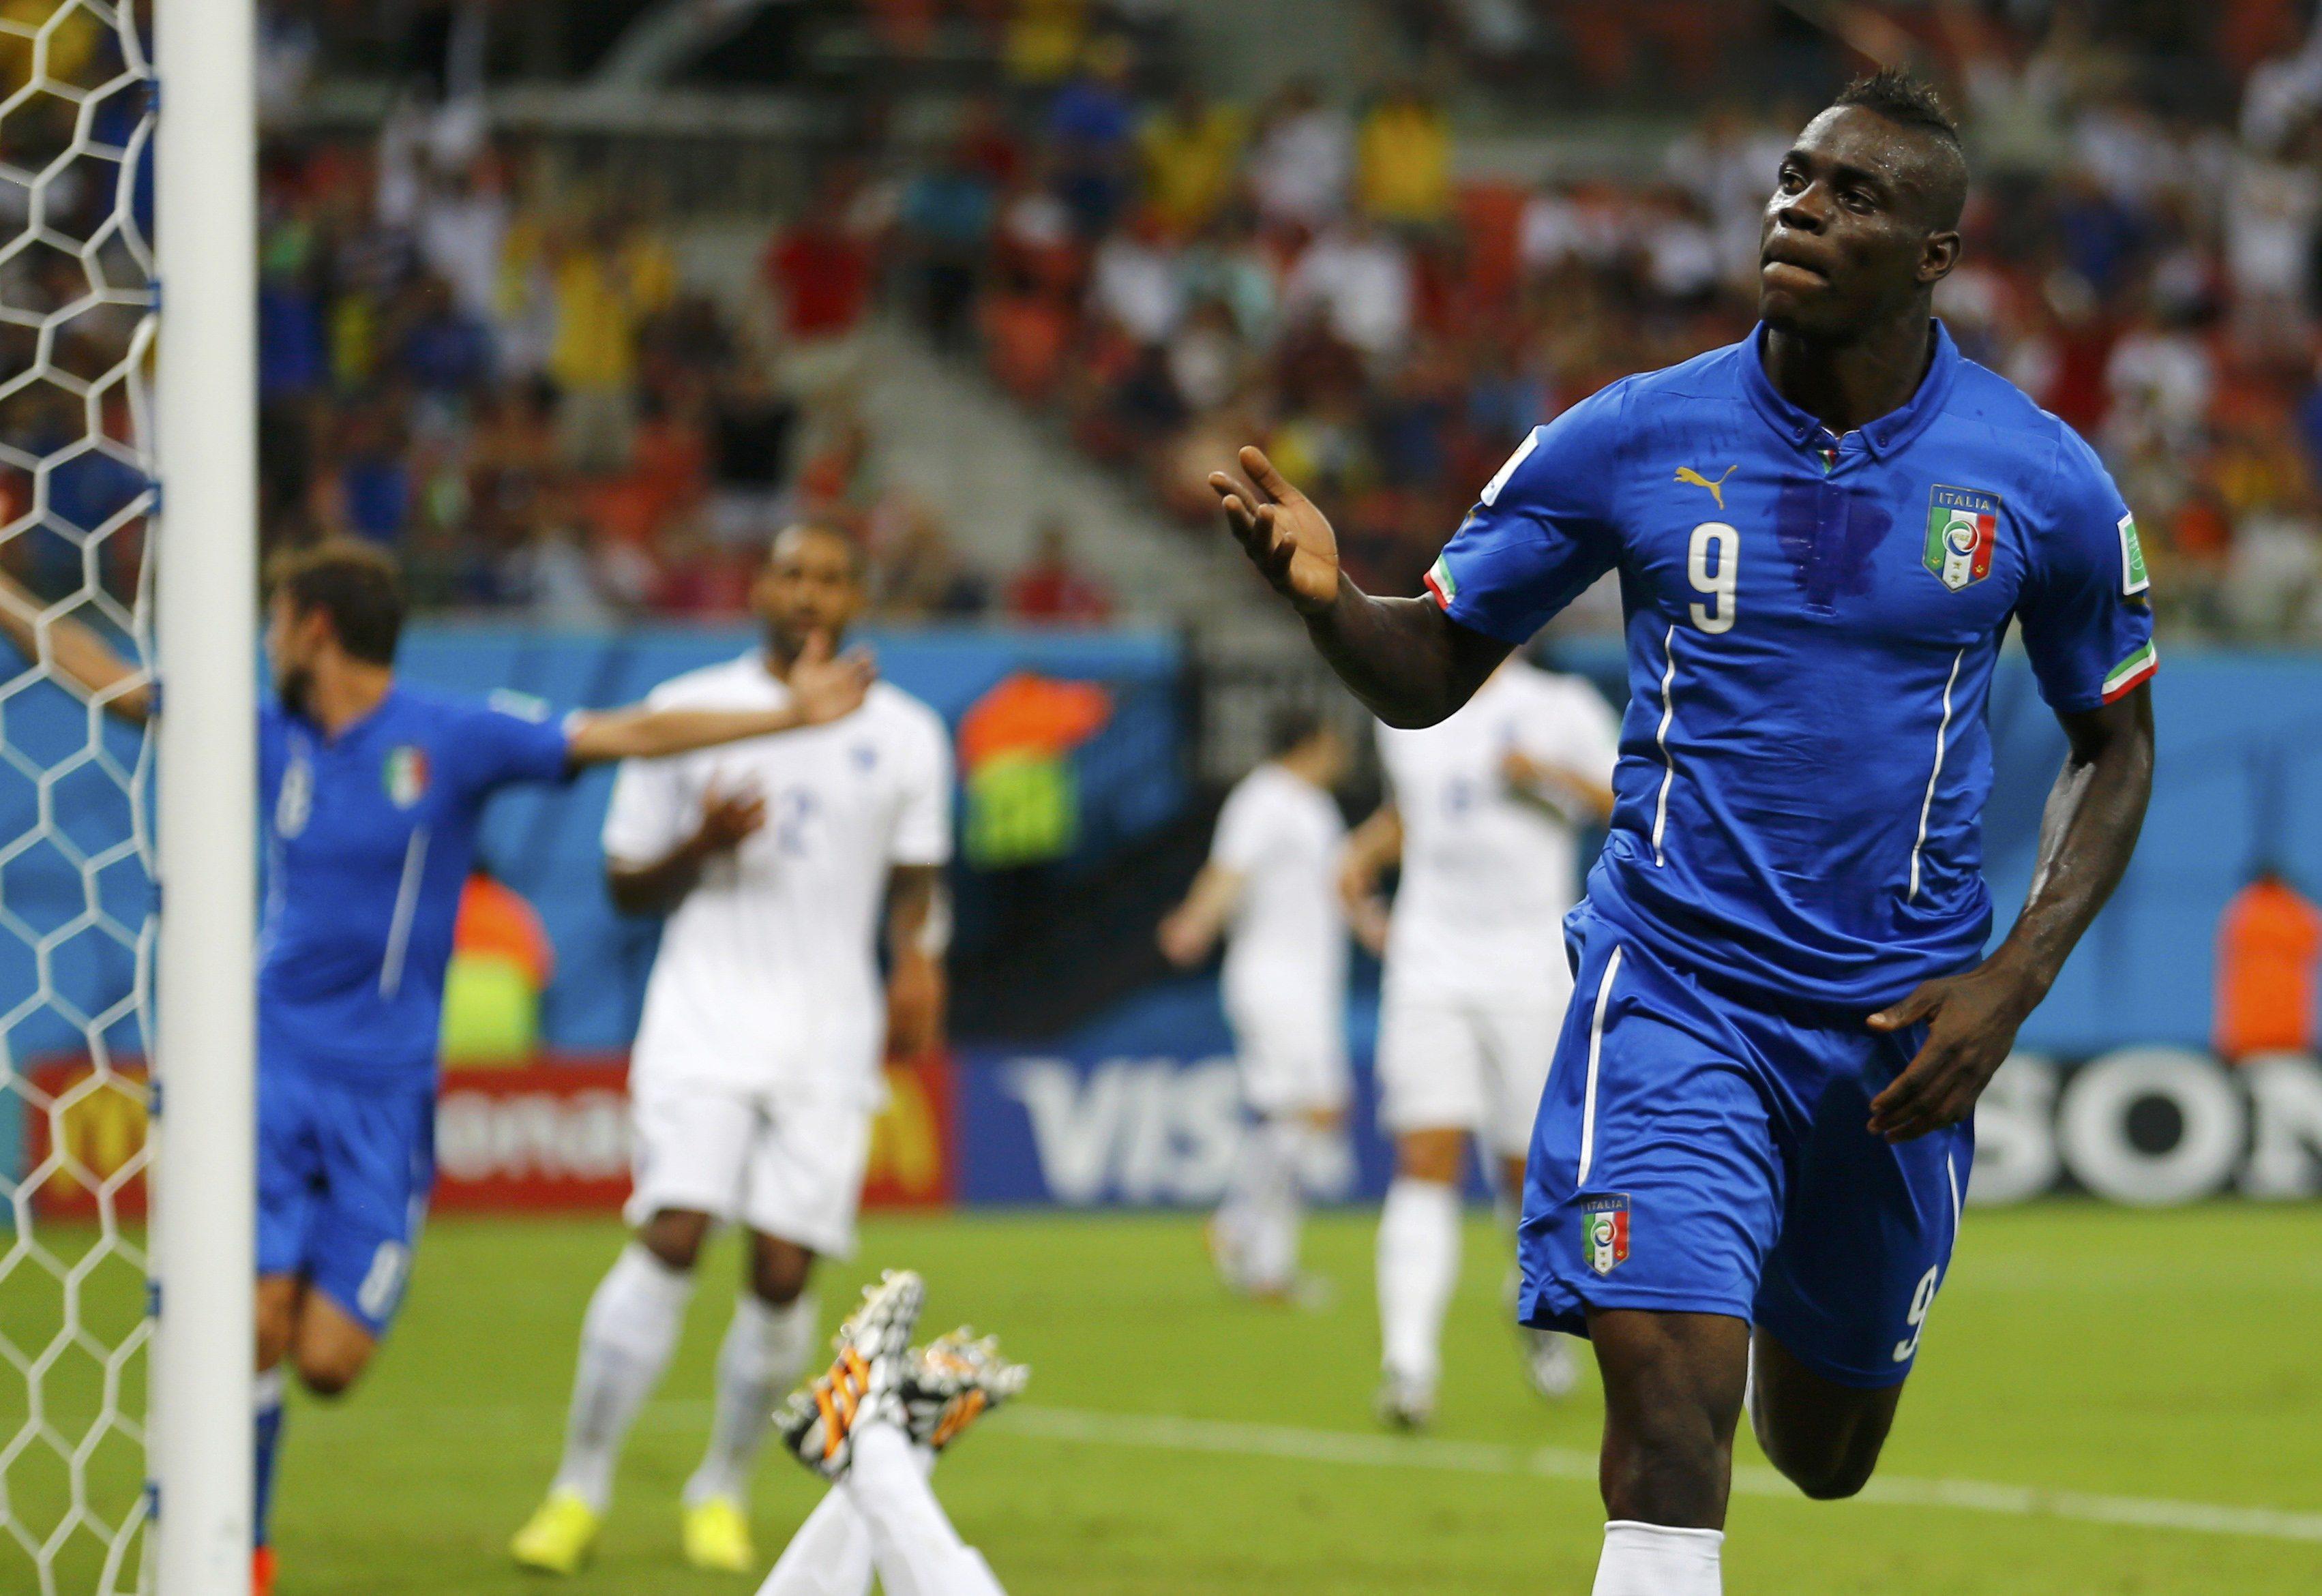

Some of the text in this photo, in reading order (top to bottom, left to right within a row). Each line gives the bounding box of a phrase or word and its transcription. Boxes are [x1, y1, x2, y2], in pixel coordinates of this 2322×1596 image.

[1939, 492, 1990, 511] ITALIA
[1688, 521, 1740, 635] 9
[1587, 1199, 1622, 1211] ITALIA
[1892, 1263, 1938, 1362] 9
